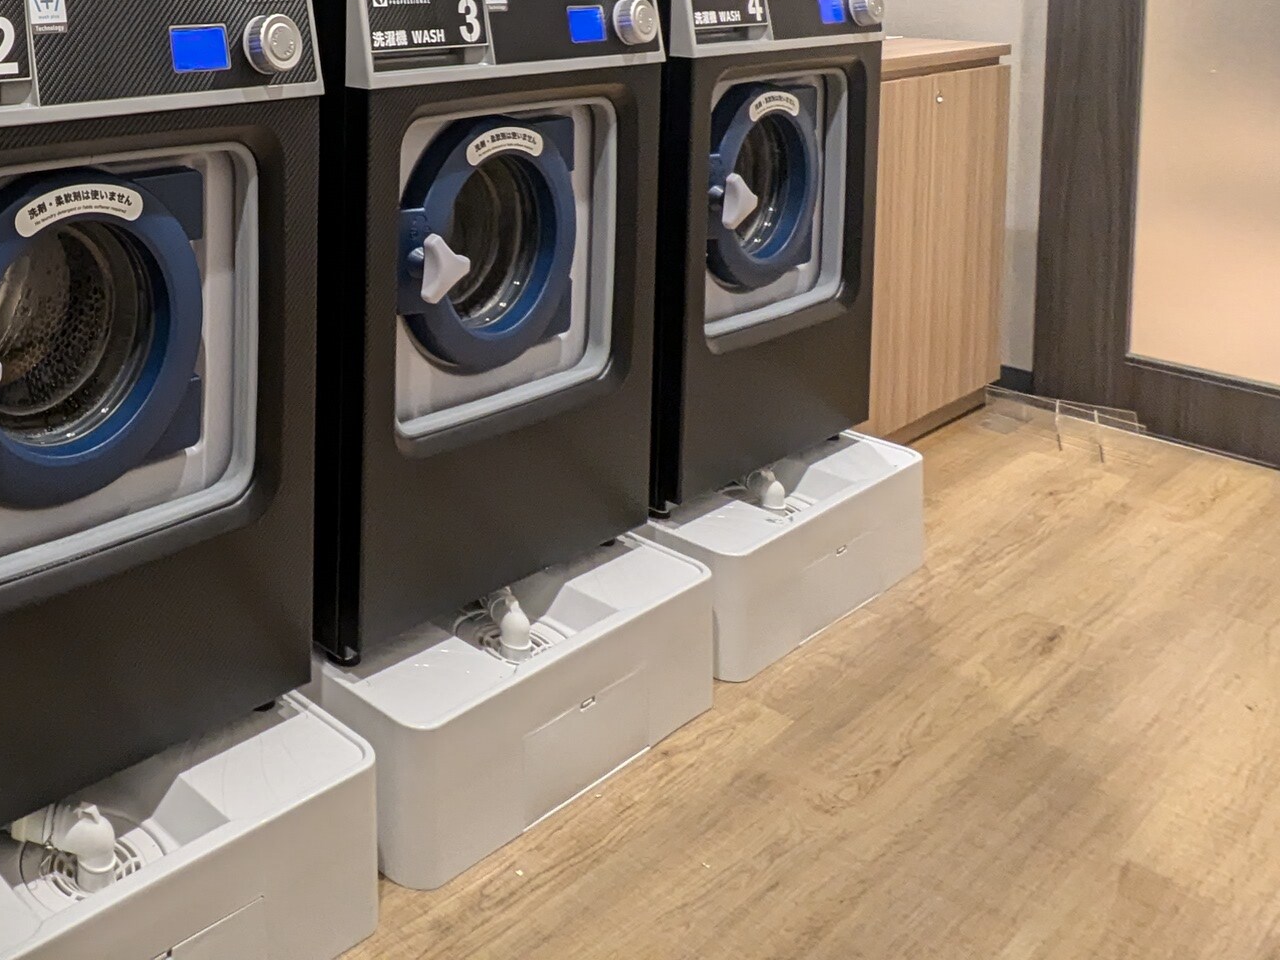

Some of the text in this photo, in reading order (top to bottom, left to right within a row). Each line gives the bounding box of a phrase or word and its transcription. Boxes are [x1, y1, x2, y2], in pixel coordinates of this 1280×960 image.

[718, 10, 741, 22] WASH
[372, 29, 445, 48] 洗濯機 WASH
[27, 189, 133, 220] 洗剤・柔軟剤は使いません
